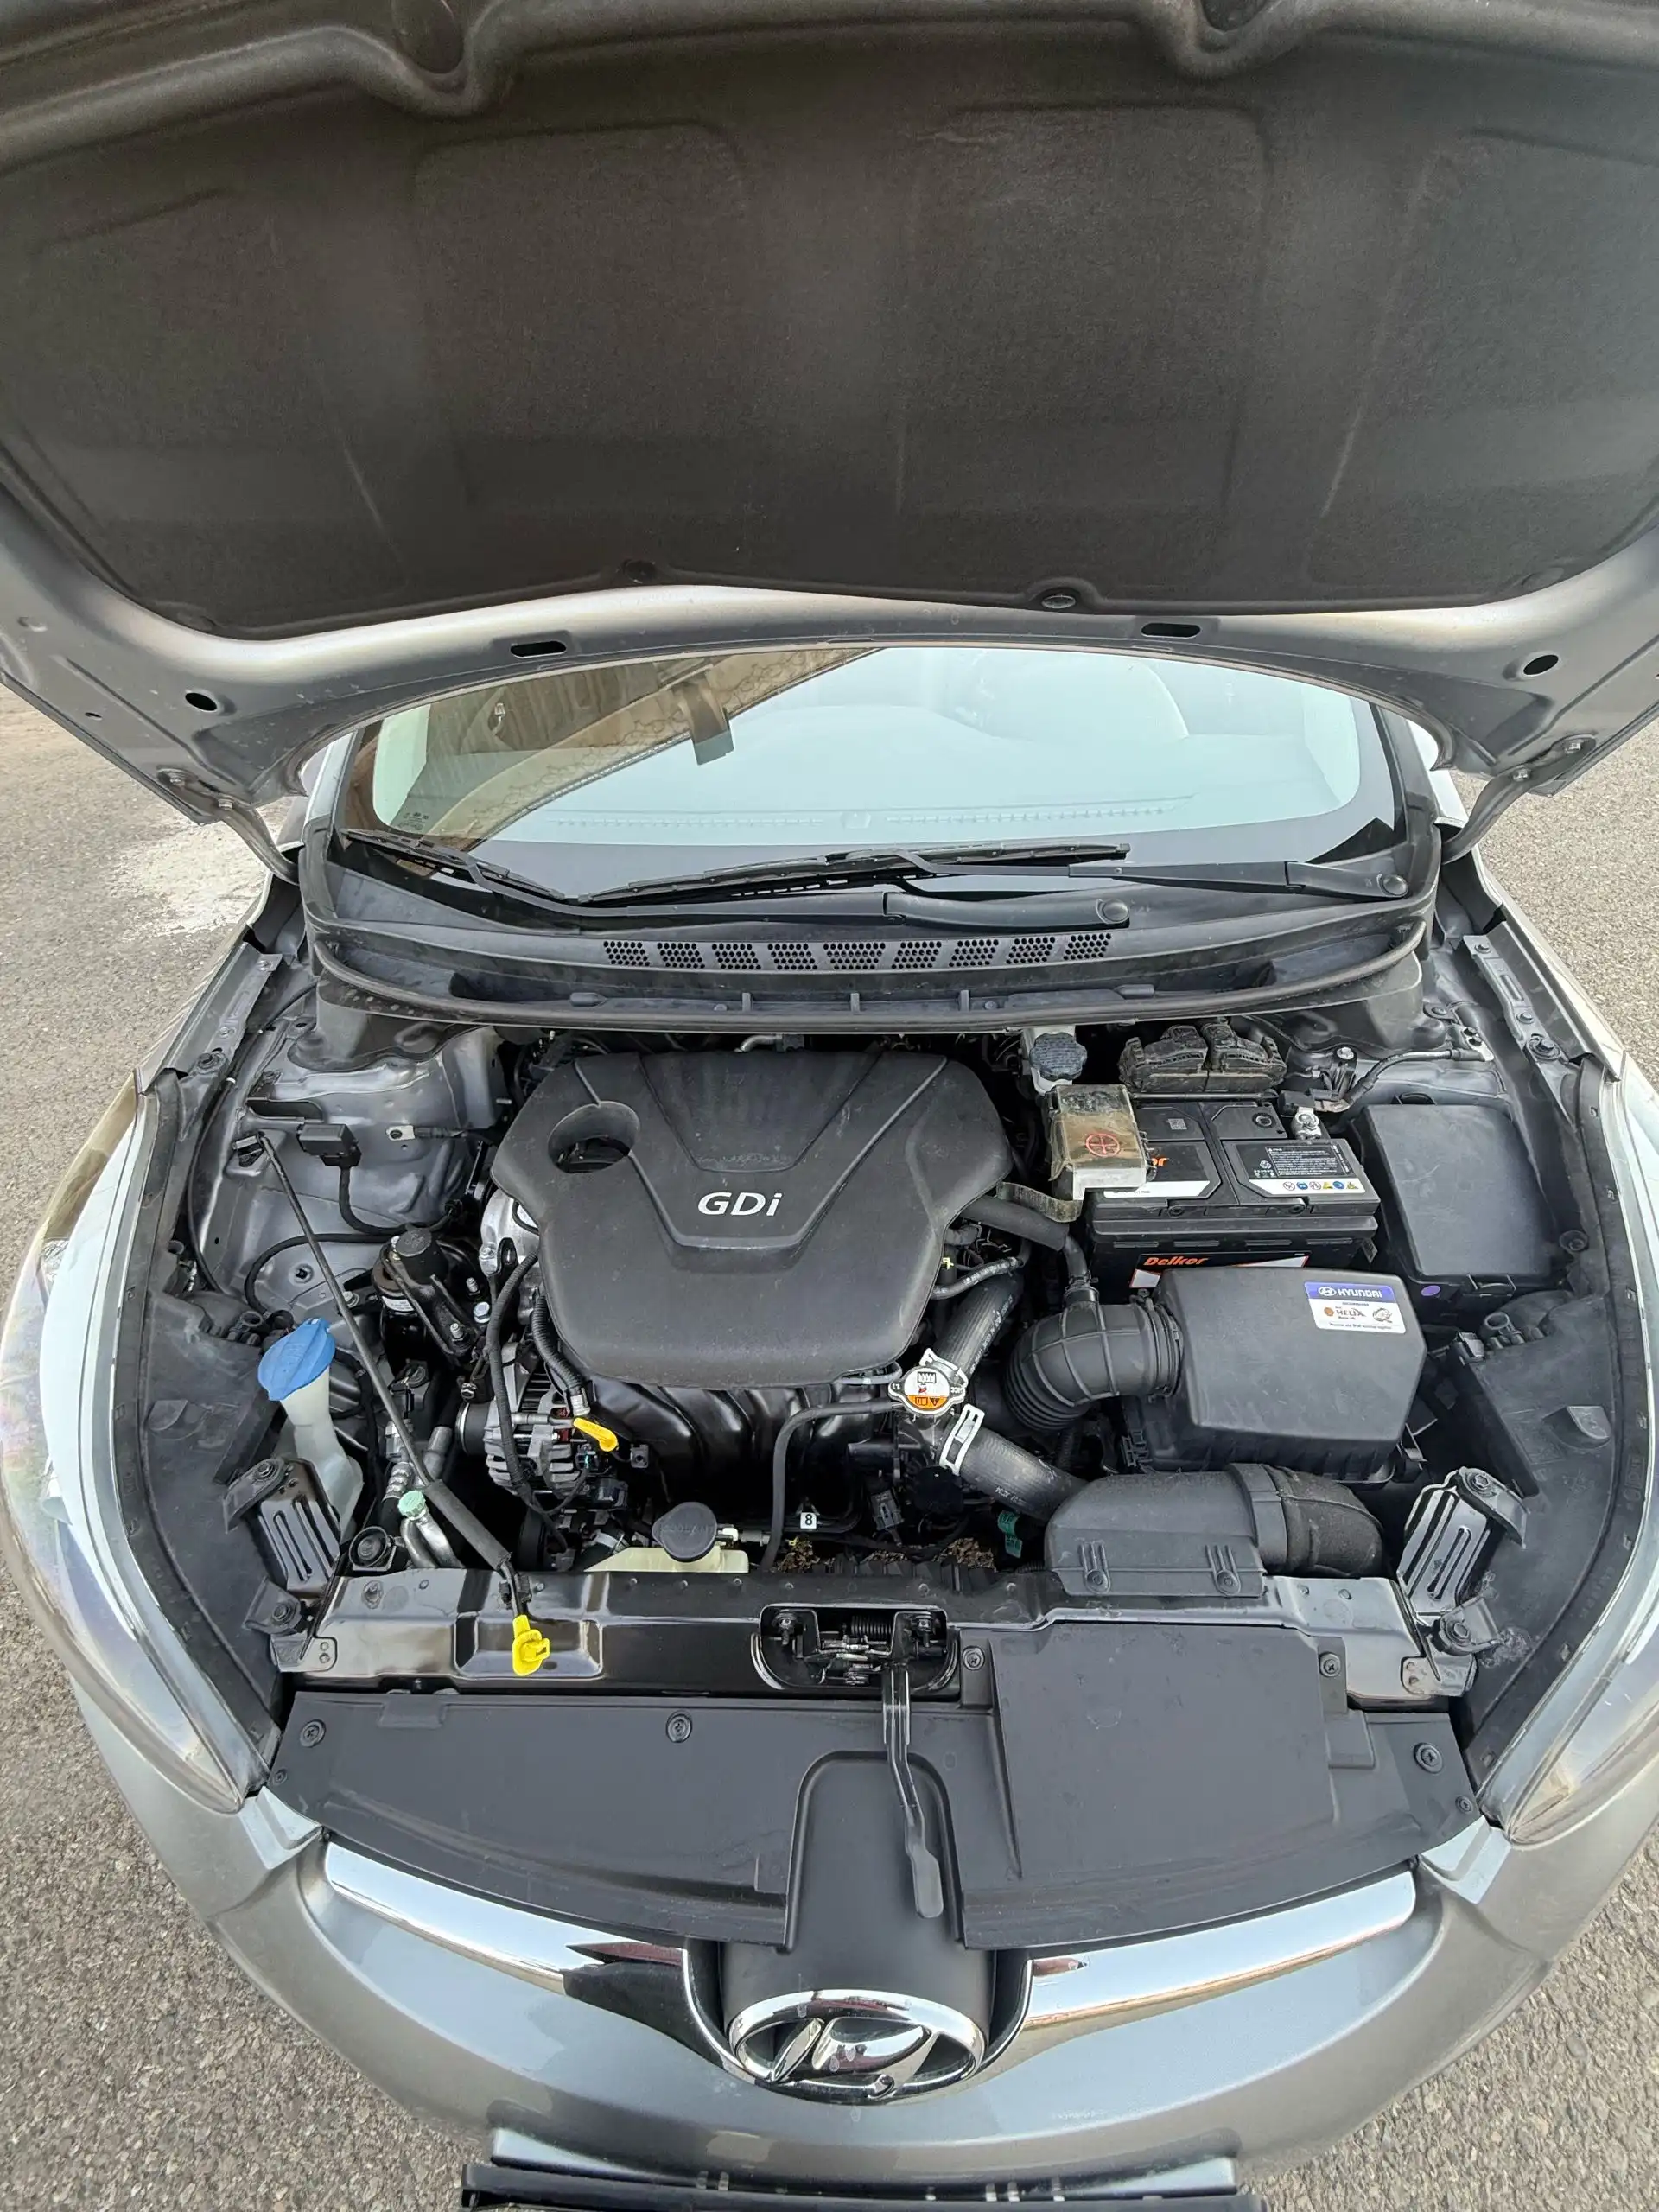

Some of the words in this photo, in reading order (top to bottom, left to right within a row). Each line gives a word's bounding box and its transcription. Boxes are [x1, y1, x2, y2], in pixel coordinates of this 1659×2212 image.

[697, 1192, 783, 1217] GDi
[1143, 1255, 1209, 1266] Delkor
[1338, 1287, 1383, 1299] HYUNDAI
[804, 1513, 813, 1526] 8
